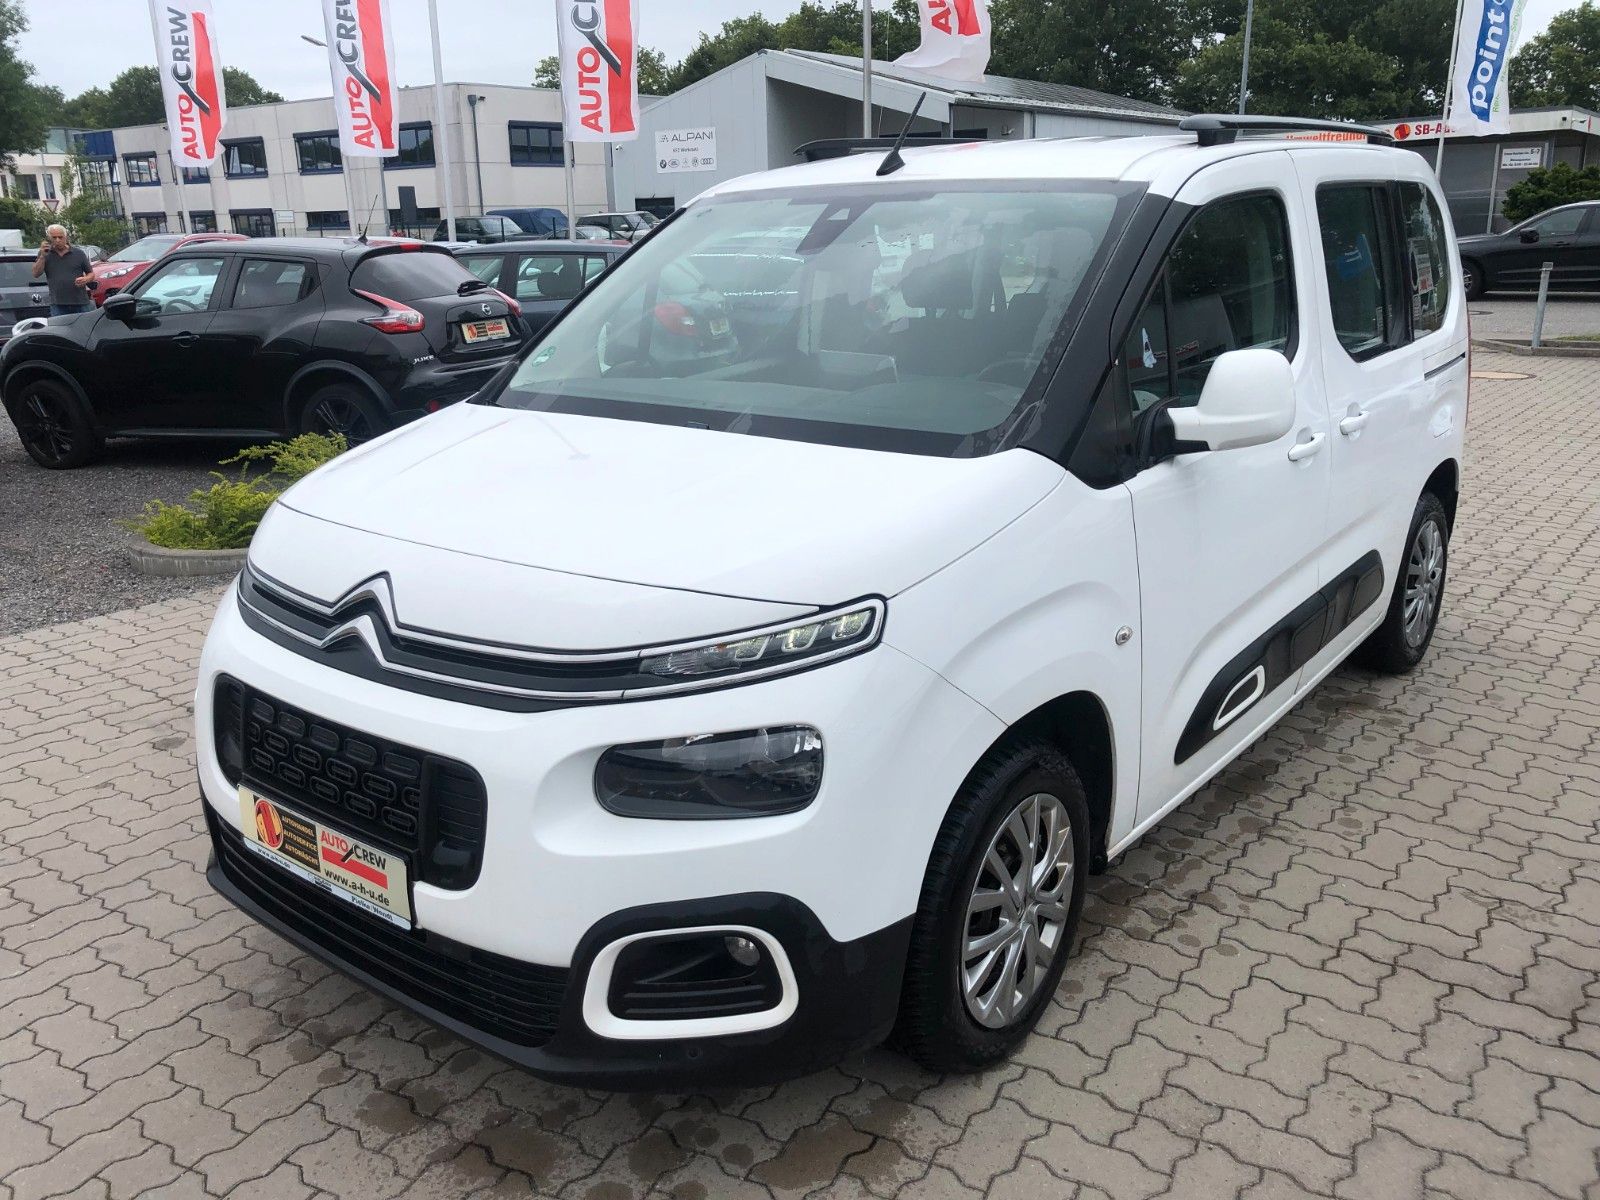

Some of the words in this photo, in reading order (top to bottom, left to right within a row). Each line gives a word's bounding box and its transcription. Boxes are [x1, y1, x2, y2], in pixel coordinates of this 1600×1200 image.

[167, 6, 193, 83] CREW
[345, 75, 376, 149] AUTO
[577, 46, 604, 134] AUTO
[178, 94, 201, 160] AUTO
[671, 131, 713, 142] ALPANI
[320, 830, 348, 853] AUTO
[353, 845, 387, 871] CREW
[324, 867, 390, 907] www.a-h-u.de
